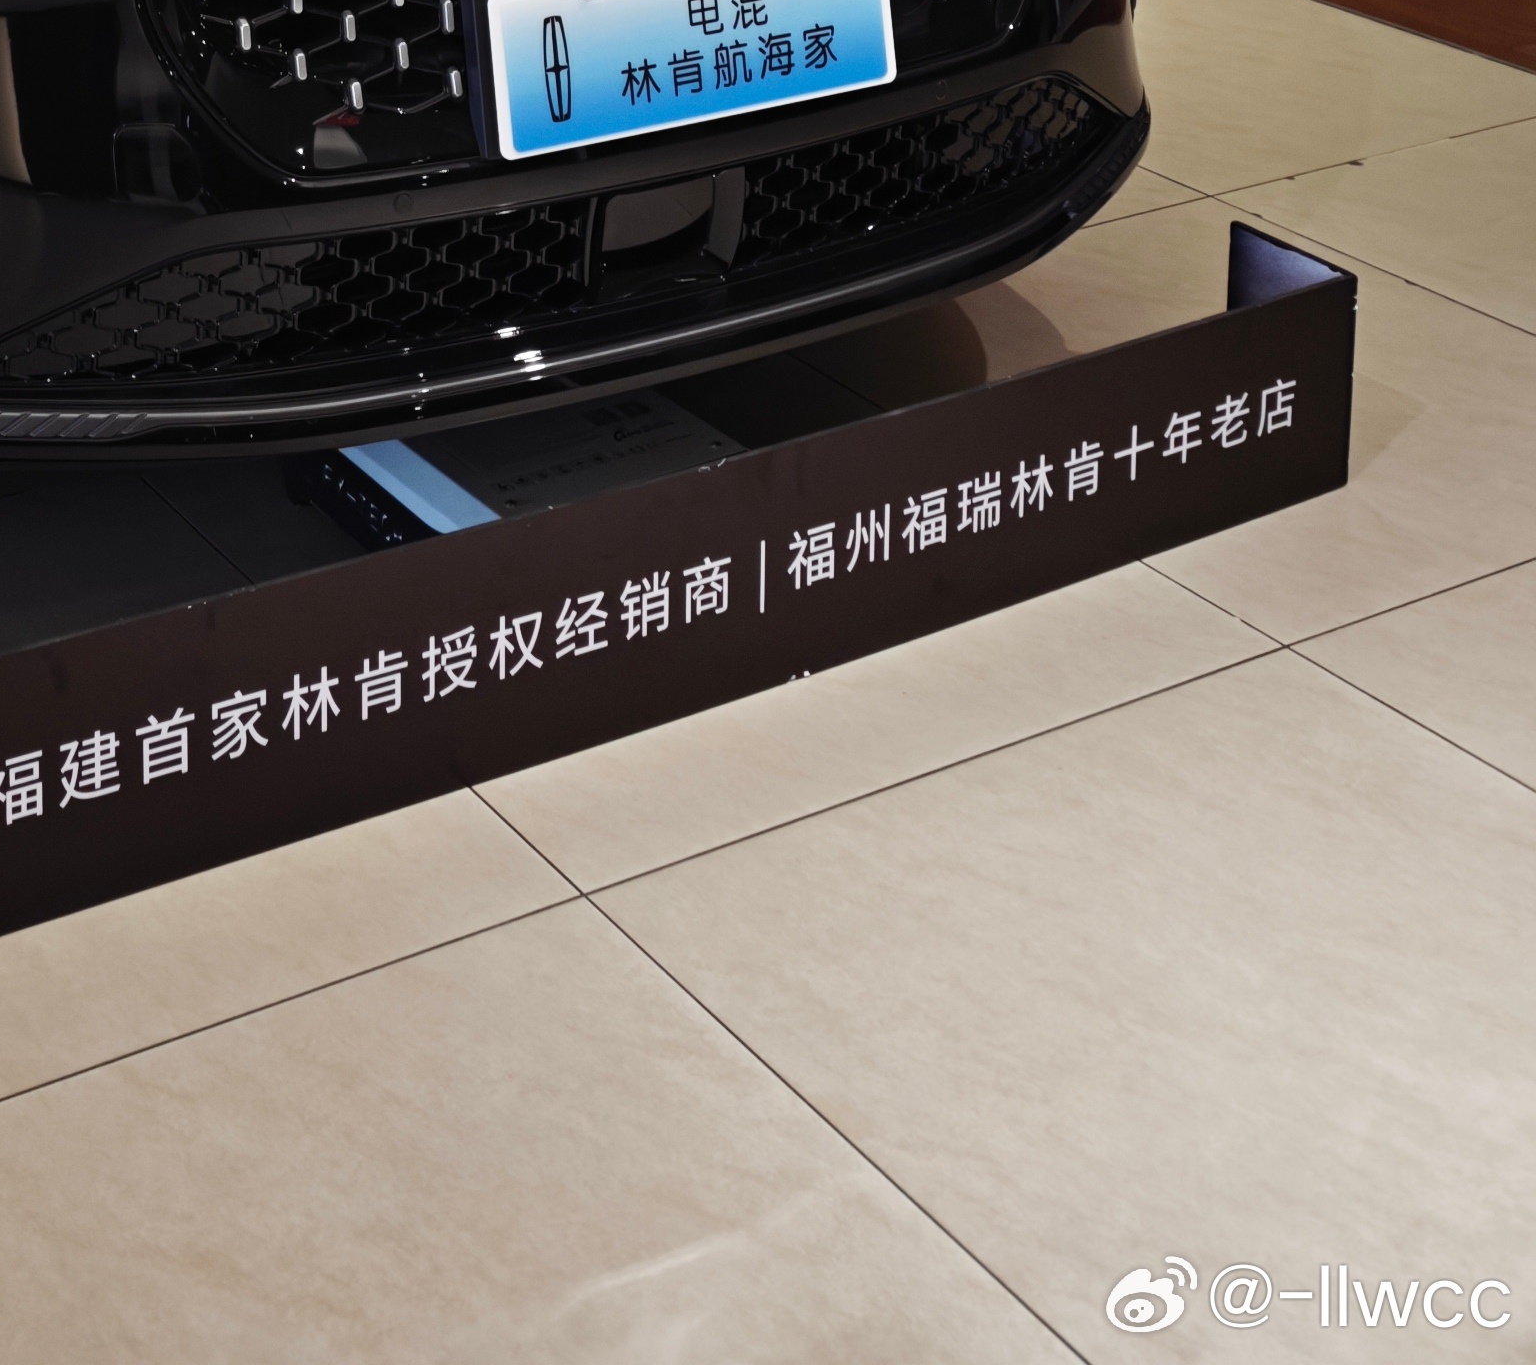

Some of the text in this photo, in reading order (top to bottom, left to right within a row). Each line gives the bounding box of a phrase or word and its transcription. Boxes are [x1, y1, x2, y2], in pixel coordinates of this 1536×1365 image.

[621, 22, 838, 106] 林肯航海家
[787, 378, 1297, 591] 福州福瑞林肯十年老店
